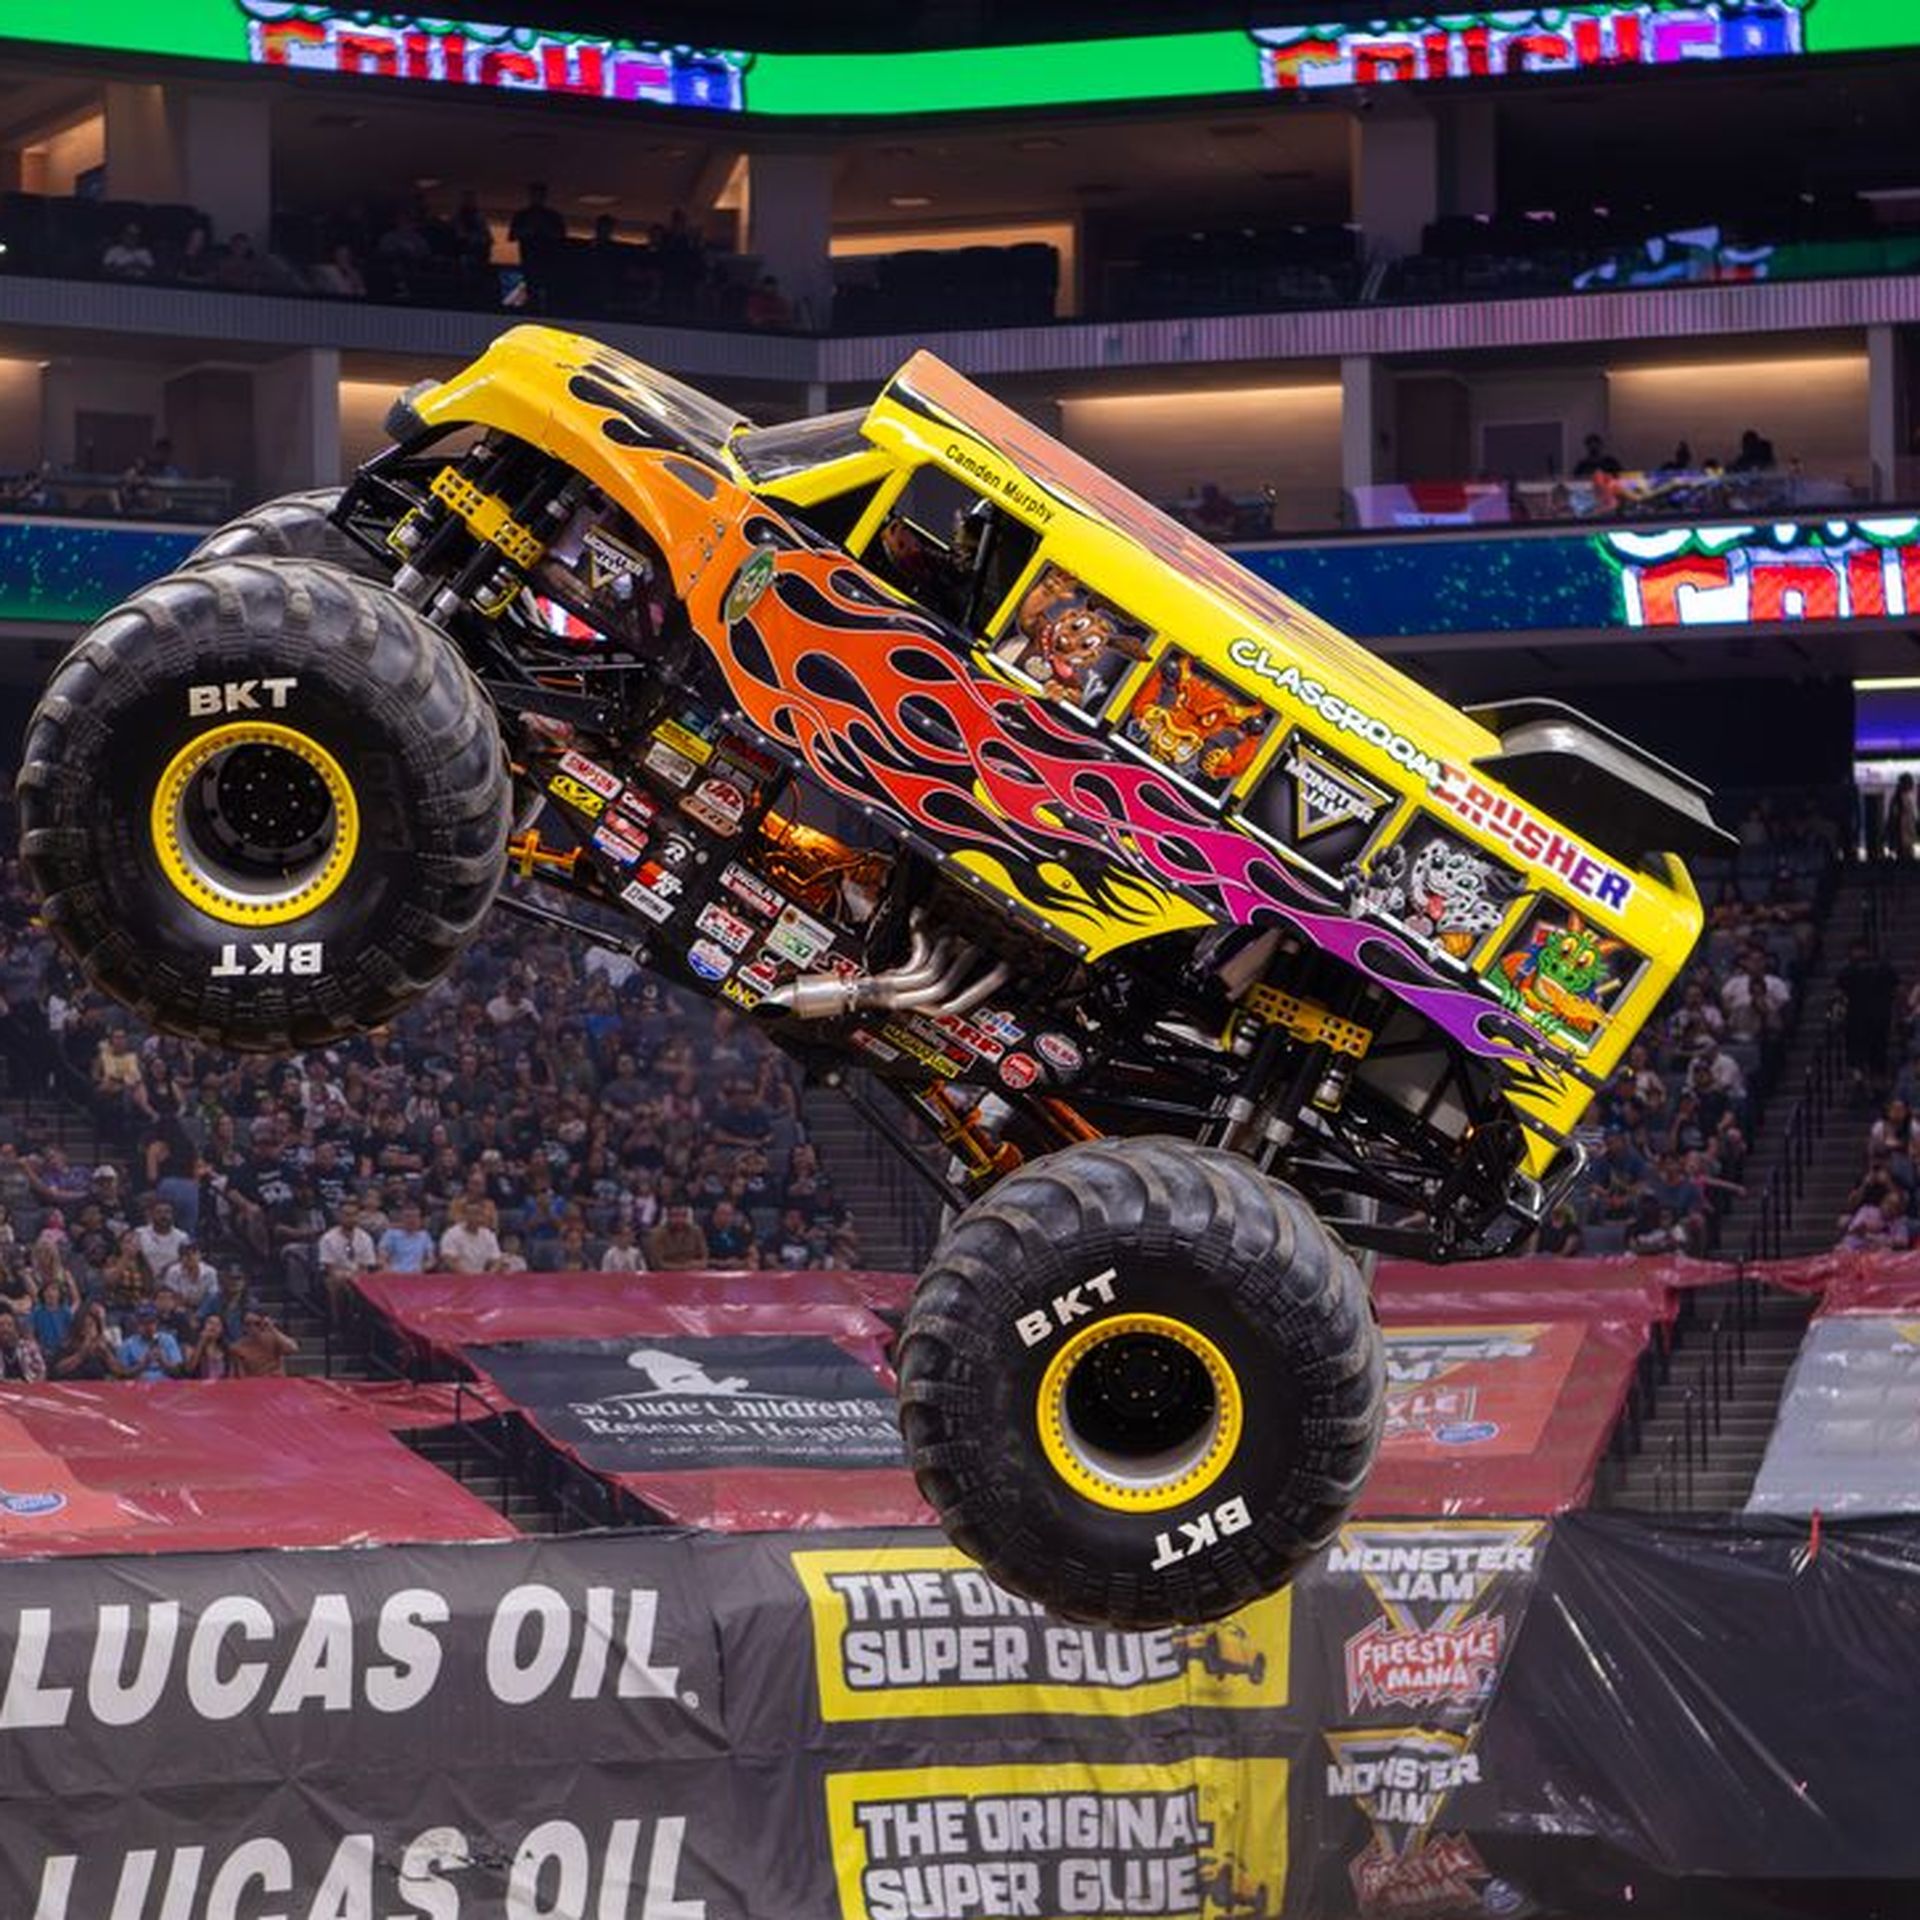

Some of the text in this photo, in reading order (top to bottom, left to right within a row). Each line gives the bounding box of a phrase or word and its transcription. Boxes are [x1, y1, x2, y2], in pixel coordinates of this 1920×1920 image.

[945, 443, 1056, 525] Camden Murphy
[188, 677, 298, 718] BKT
[1229, 637, 1634, 913] CLASSROOM CRUSHER
[1284, 757, 1376, 824] MONSTER
[1301, 790, 1347, 818] JAM
[211, 942, 323, 977] BKT
[934, 1014, 1004, 1055] ARP
[1015, 1268, 1118, 1348] BKT
[581, 1417, 904, 1443] Research Hospital
[619, 1401, 701, 1419] Jude
[704, 1398, 884, 1419] Children's
[1150, 1496, 1254, 1572] BKT
[1326, 1546, 1536, 1573] MONSTER
[831, 1573, 950, 1621] THE
[1382, 1572, 1475, 1601] JAM
[0, 1585, 450, 1729] LUCAS
[845, 1625, 1181, 1687] SUPER GLUE
[1357, 1630, 1497, 1677] FREESTYLE
[1386, 1661, 1470, 1689] MANIA
[857, 1800, 969, 1860] THE
[1374, 1788, 1430, 1825] JAM
[504, 1816, 707, 1920] OIL
[864, 1855, 1200, 1920] SUPER GLUE
